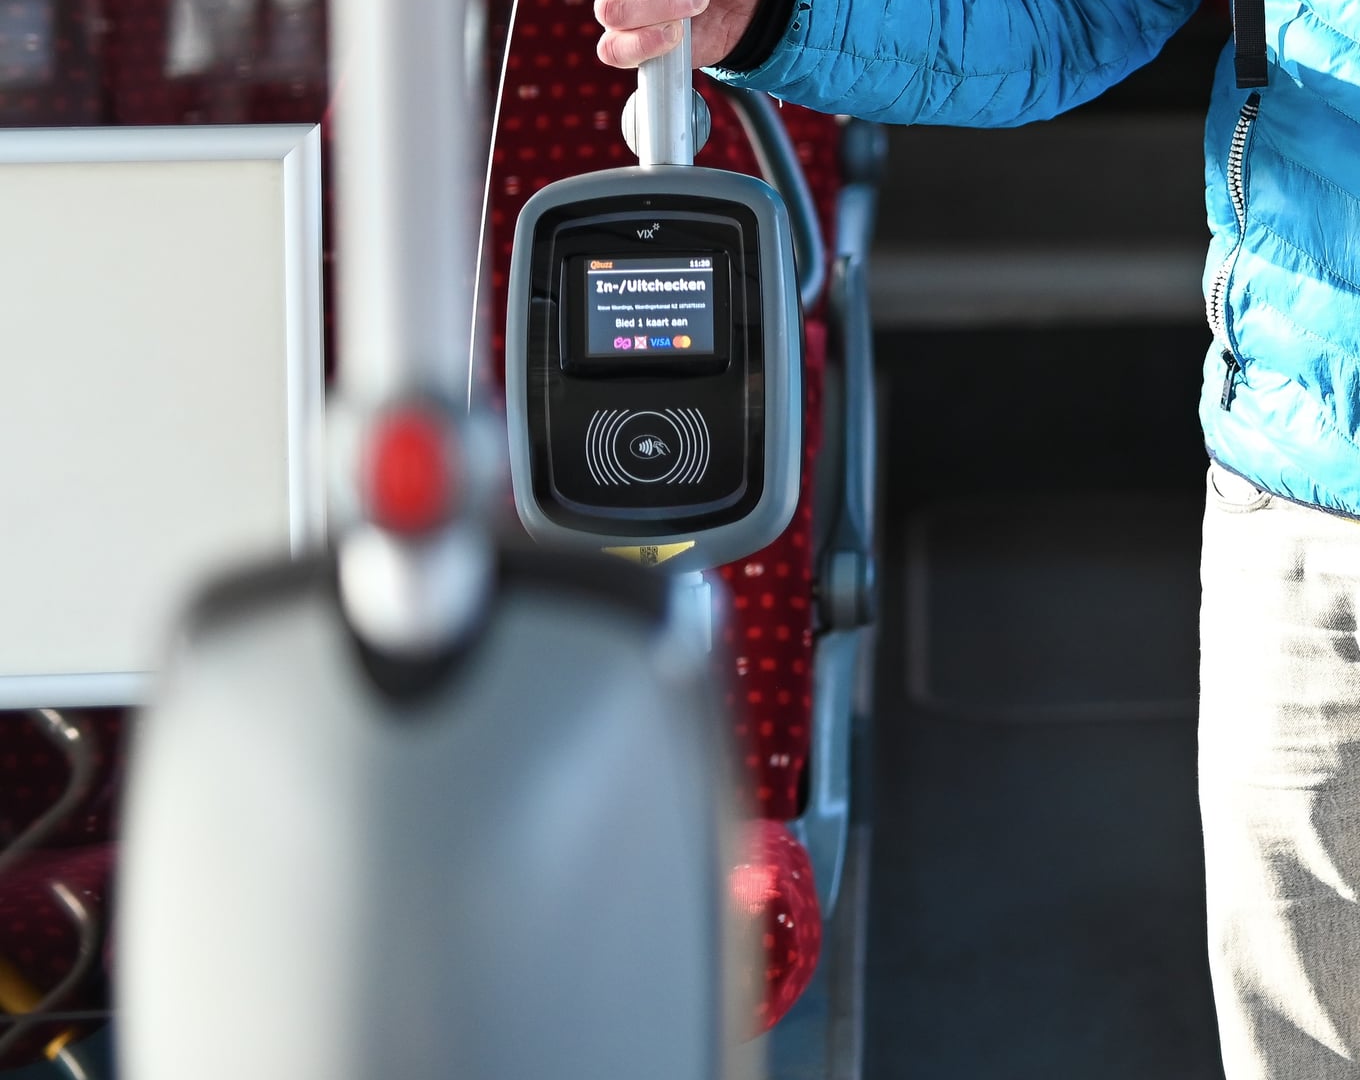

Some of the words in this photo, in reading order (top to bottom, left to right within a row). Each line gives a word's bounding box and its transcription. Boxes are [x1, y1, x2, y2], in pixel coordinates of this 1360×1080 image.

[596, 278, 706, 295] In-/Uitchecken
[646, 318, 669, 327] kaart
[671, 319, 688, 327] aan
[650, 337, 671, 348] VISA
